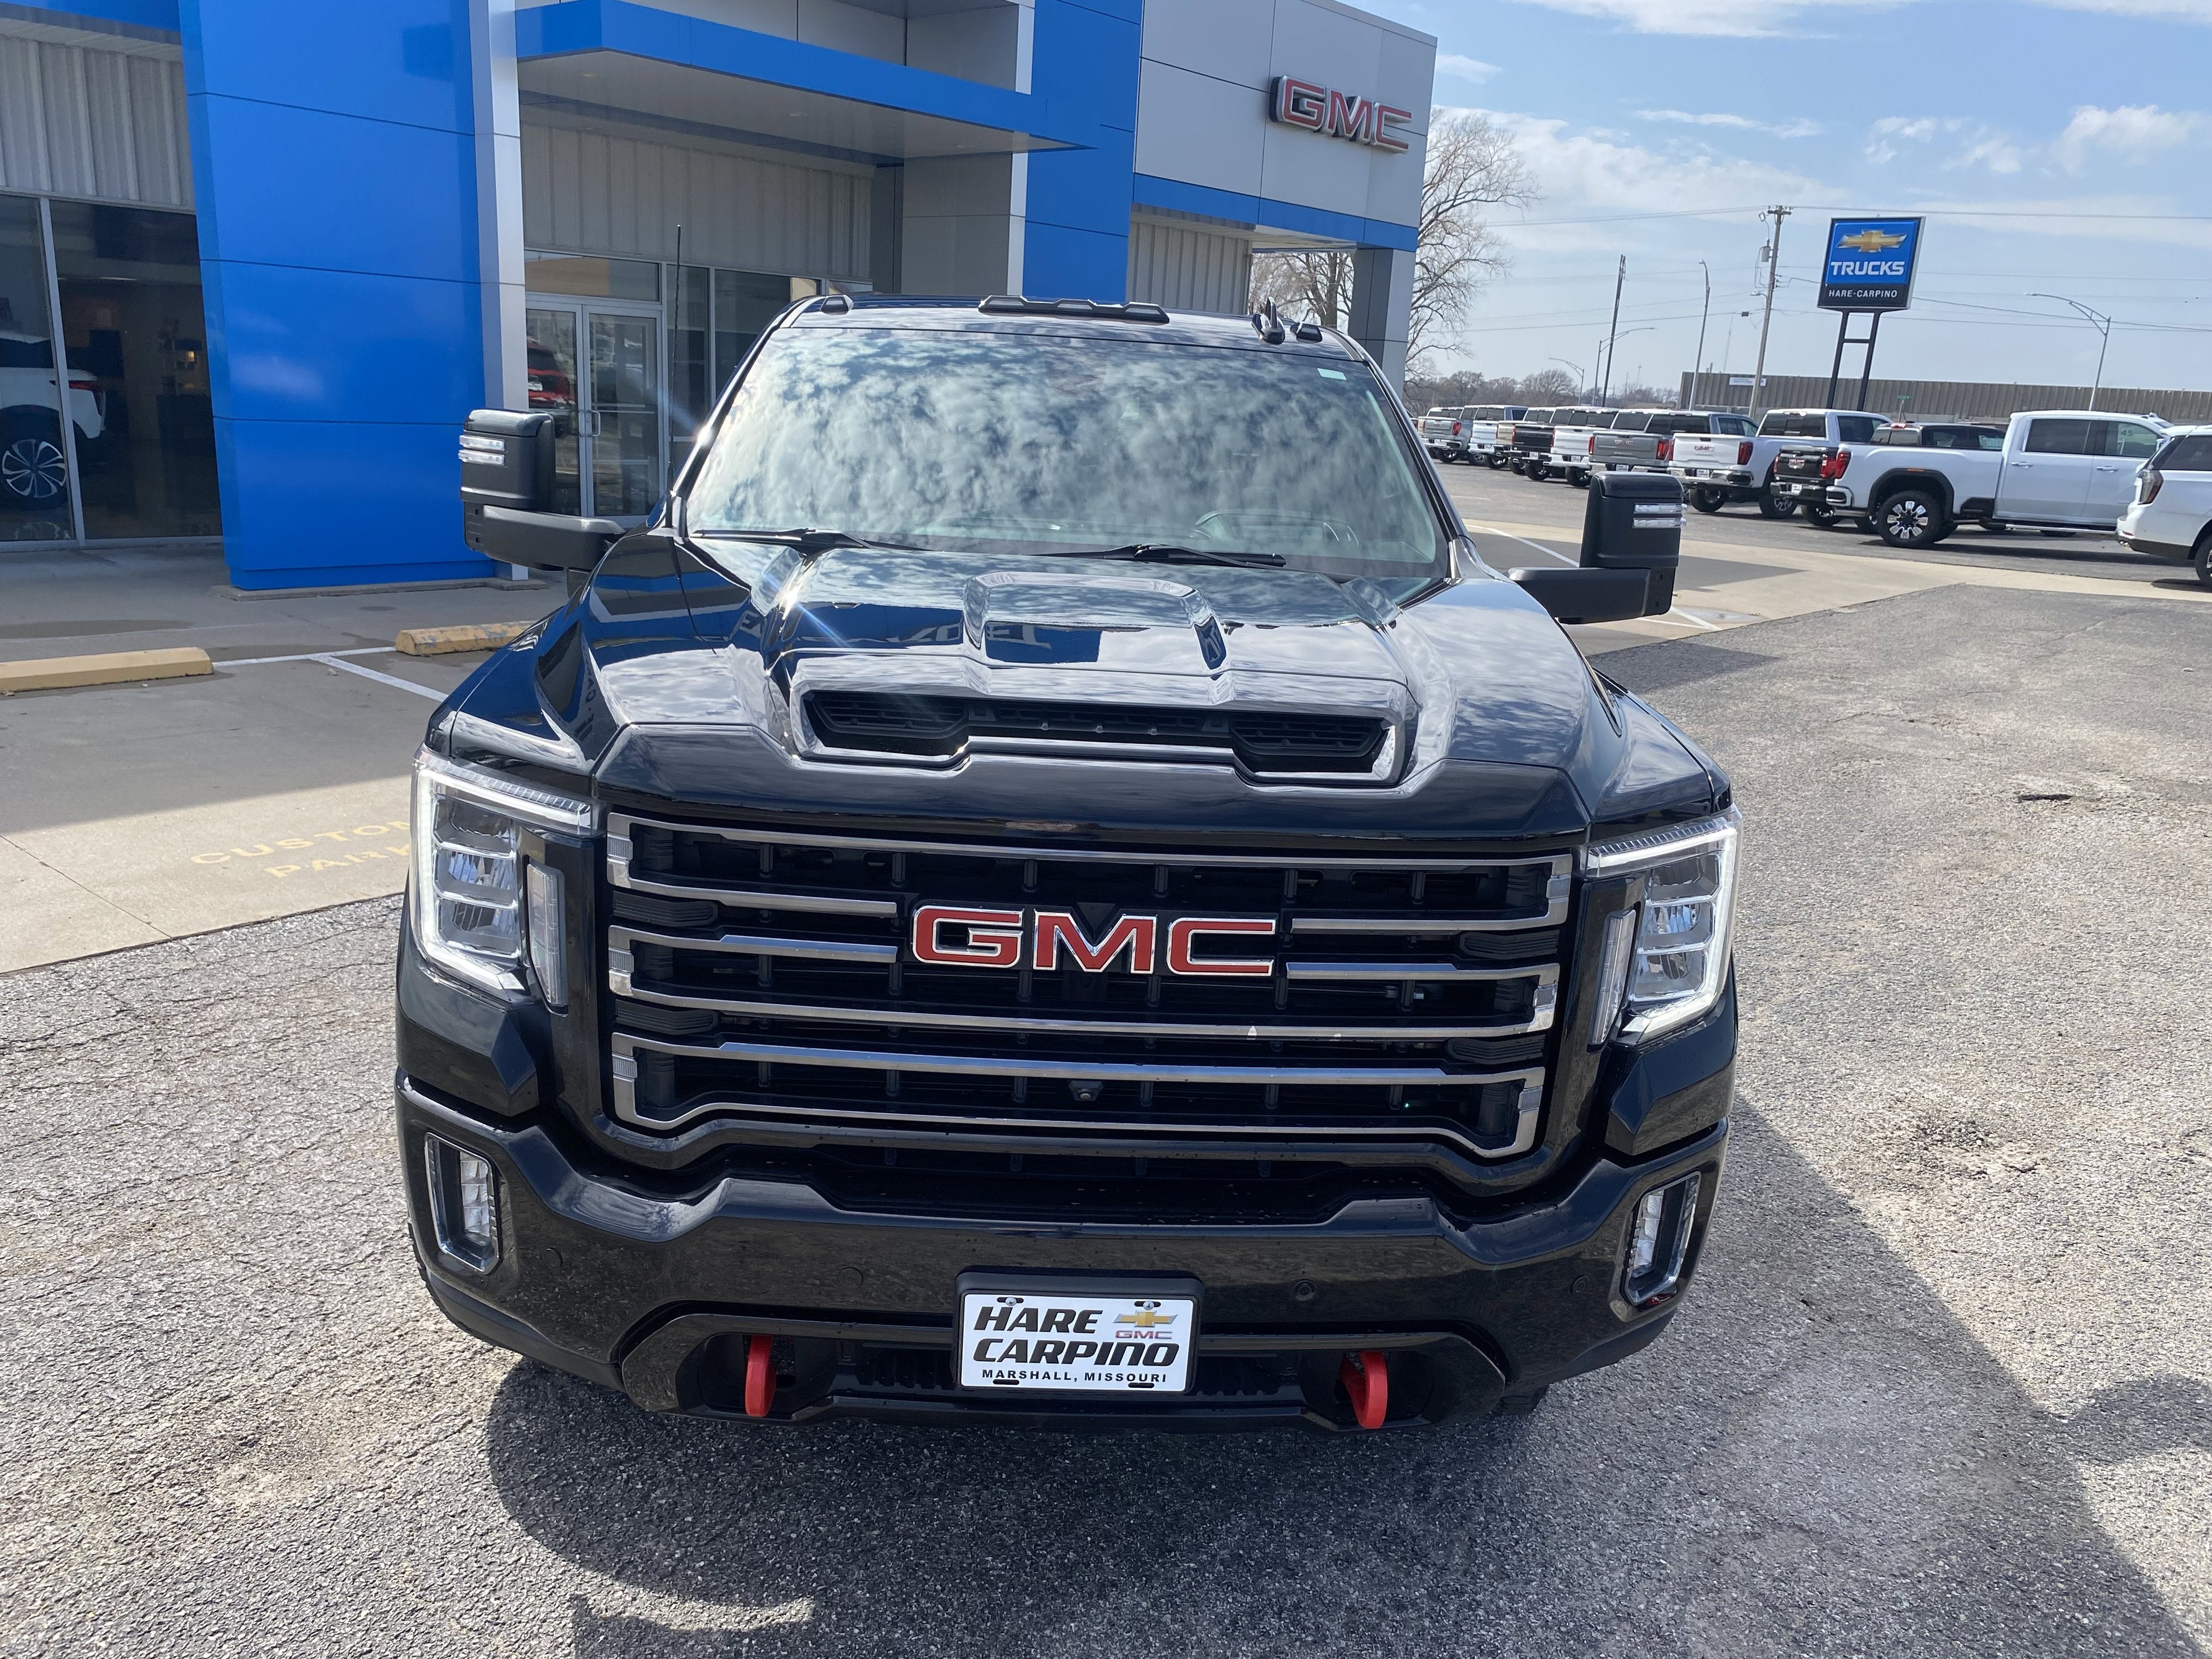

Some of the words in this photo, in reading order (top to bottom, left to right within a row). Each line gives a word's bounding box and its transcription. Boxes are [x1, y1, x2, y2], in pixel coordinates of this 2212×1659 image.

[1275, 75, 1413, 154] GMC
[1830, 261, 1905, 276] TRUCKS
[1829, 289, 1898, 298] HARE-CARPINO
[912, 905, 1277, 977] GMC
[973, 1306, 1103, 1334] HARE
[1115, 1330, 1172, 1339] GMC
[973, 1339, 1180, 1367] CARPINO
[982, 1369, 1077, 1382] MARSHALL,
[1084, 1373, 1167, 1383] MISSOURI
